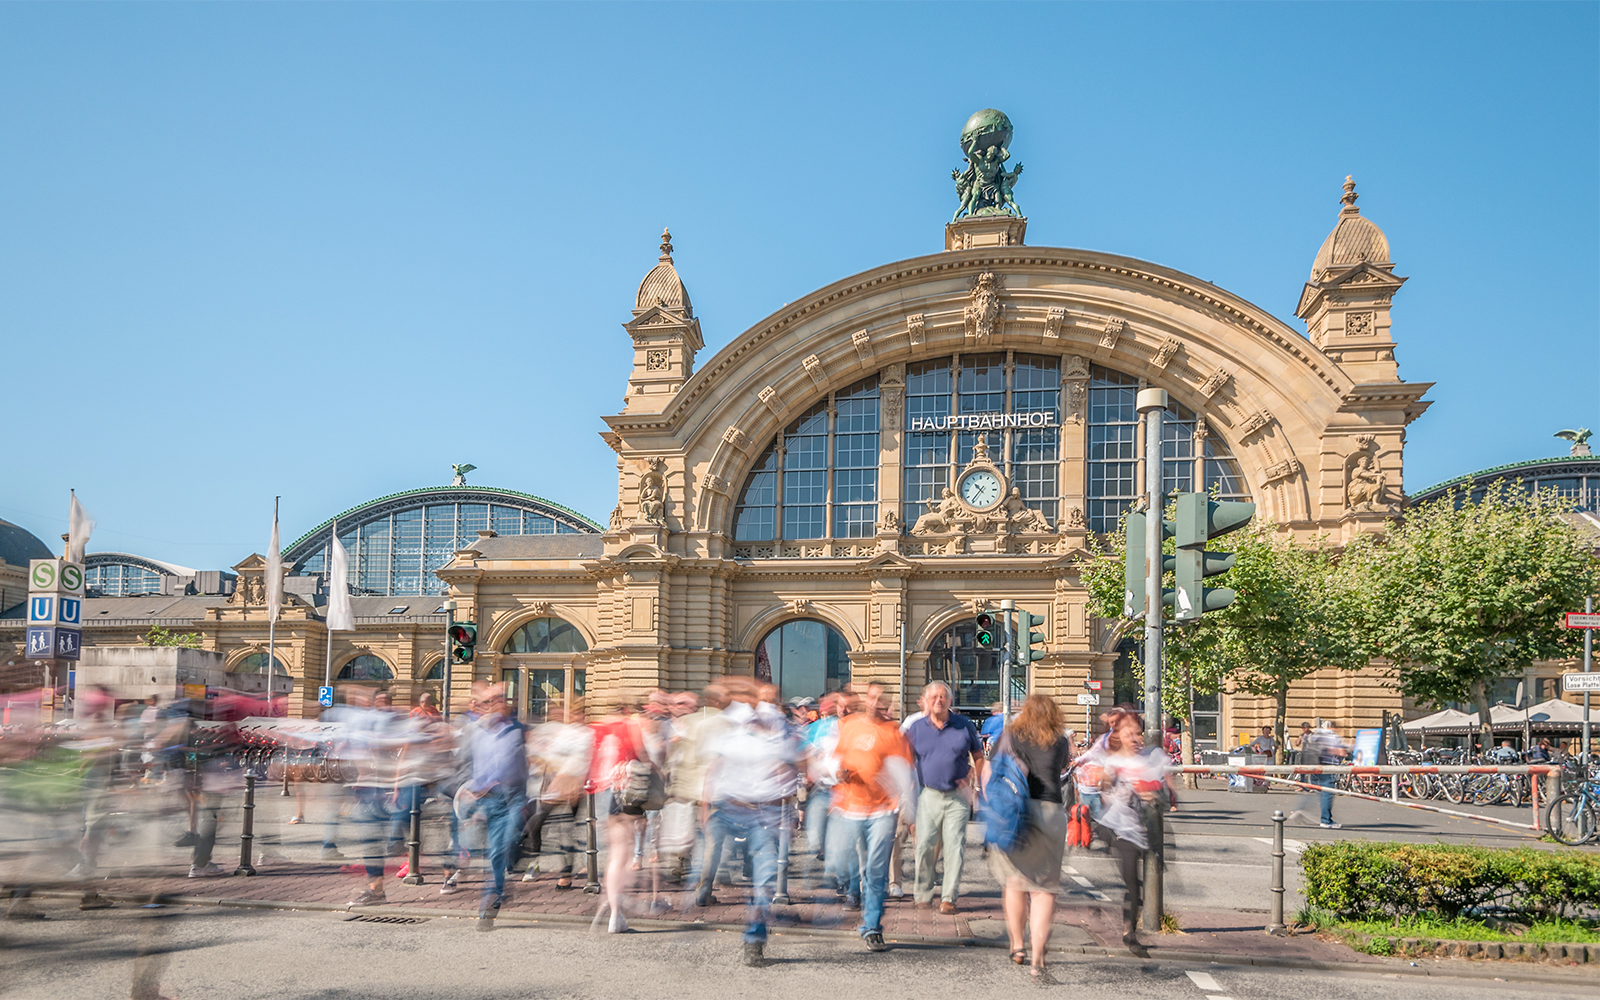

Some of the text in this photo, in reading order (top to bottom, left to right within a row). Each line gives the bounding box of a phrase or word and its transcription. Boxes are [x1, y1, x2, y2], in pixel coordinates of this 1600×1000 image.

[911, 412, 1055, 430] HAUPTBAHNHOF
[35, 563, 52, 586] S
[63, 566, 80, 589] S
[35, 599, 49, 620] U
[63, 600, 77, 621] U
[320, 688, 327, 699] P
